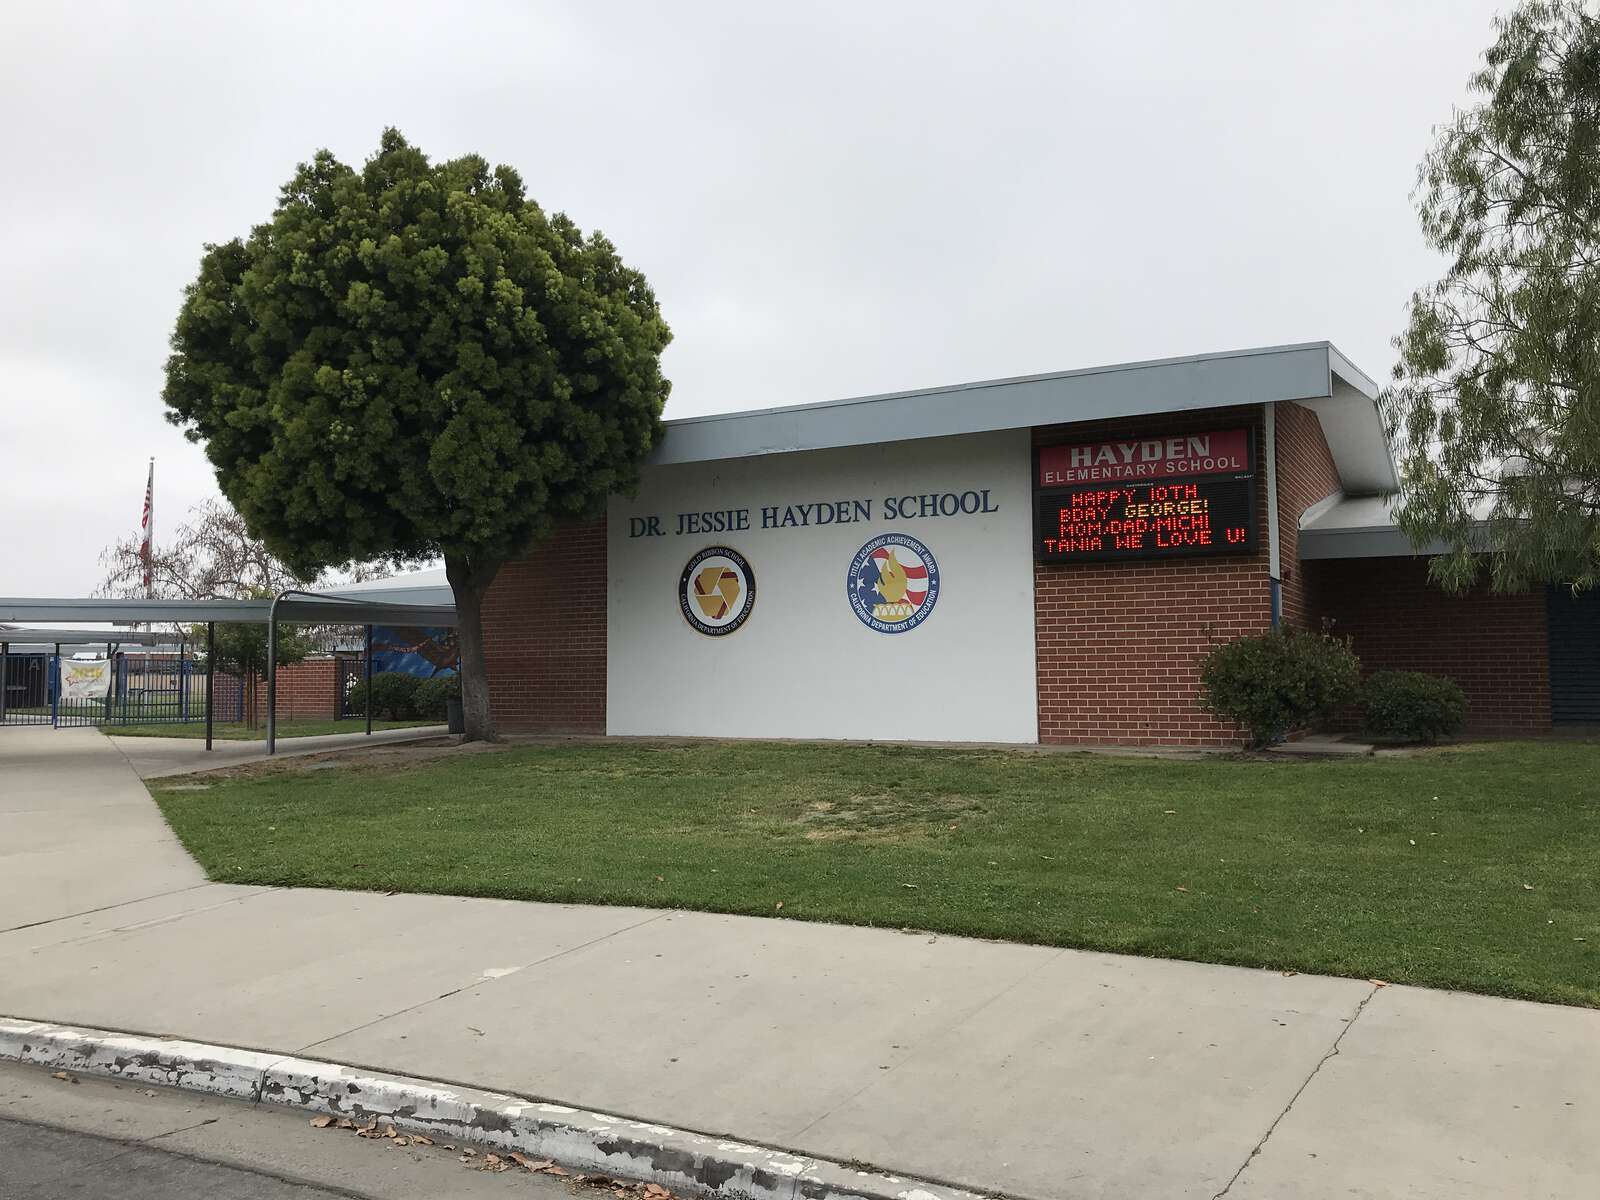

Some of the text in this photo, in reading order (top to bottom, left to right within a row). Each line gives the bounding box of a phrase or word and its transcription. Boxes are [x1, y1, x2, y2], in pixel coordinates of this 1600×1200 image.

[1071, 436, 1211, 468] HAYDEN
[1045, 456, 1241, 483] ELEMENTARY SCHOOL
[1072, 484, 1197, 507] HAPPY 10TH
[629, 489, 999, 538] DR. JESSIE HAYDEN SCHOOL
[1060, 499, 1209, 522] BDAY GEORGE!
[1044, 528, 1245, 553] TANIA WE LOVE U!
[724, 549, 745, 568] SCHOOL
[860, 537, 886, 557] ACADEMIC
[887, 536, 925, 554] ACHIEVEMENT
[921, 553, 936, 574] AWARD
[850, 590, 936, 632] CALIFORNIA DEPARTMENT OF EDUCATION
